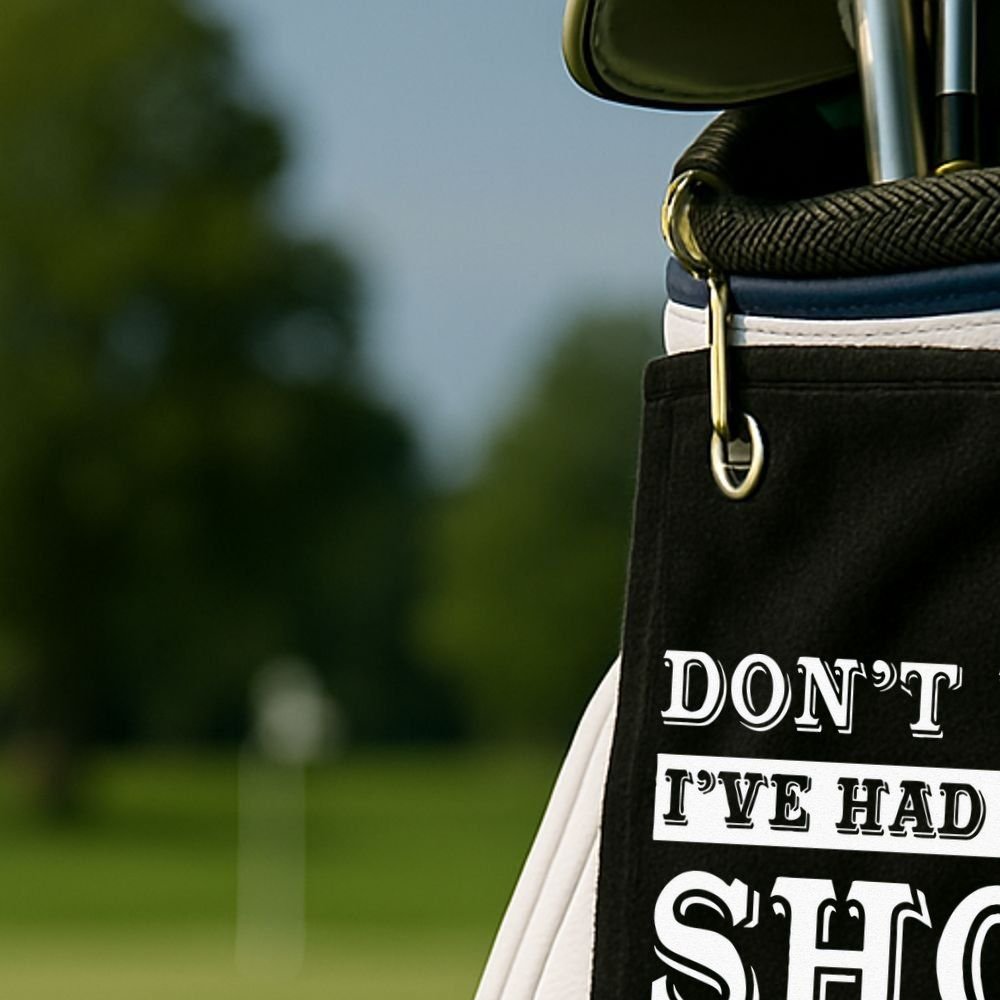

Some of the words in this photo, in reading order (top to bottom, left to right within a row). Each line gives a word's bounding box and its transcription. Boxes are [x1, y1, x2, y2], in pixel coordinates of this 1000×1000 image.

[661, 650, 962, 738] DON'T
[664, 768, 812, 829] I'VE
[836, 778, 986, 839] HAD
